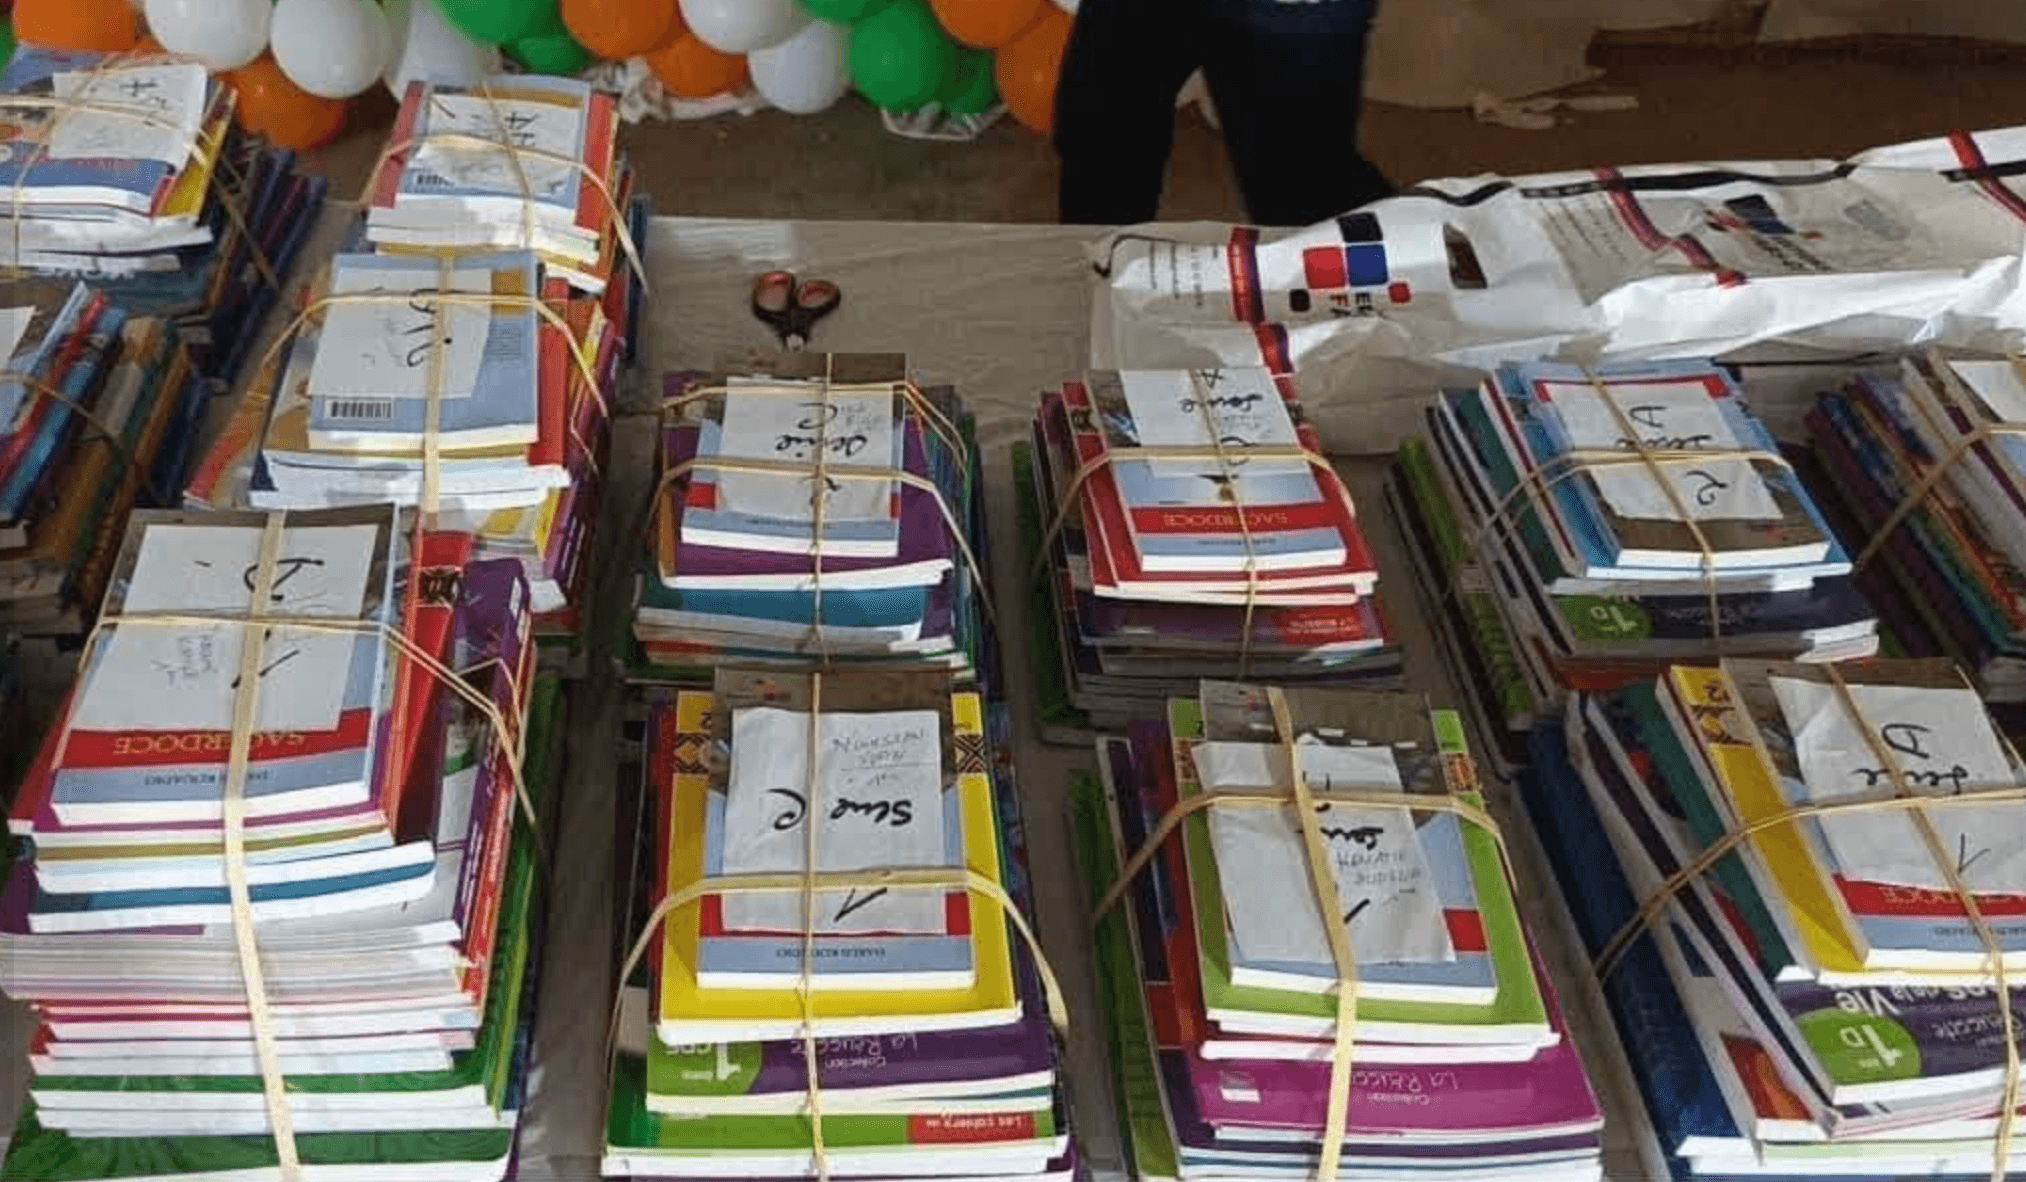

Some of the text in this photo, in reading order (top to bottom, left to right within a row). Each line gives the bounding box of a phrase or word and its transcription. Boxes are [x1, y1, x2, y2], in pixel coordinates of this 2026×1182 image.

[1686, 471, 1729, 506] 2
[1956, 833, 1992, 875] 1
[1839, 1026, 1865, 1048] D
